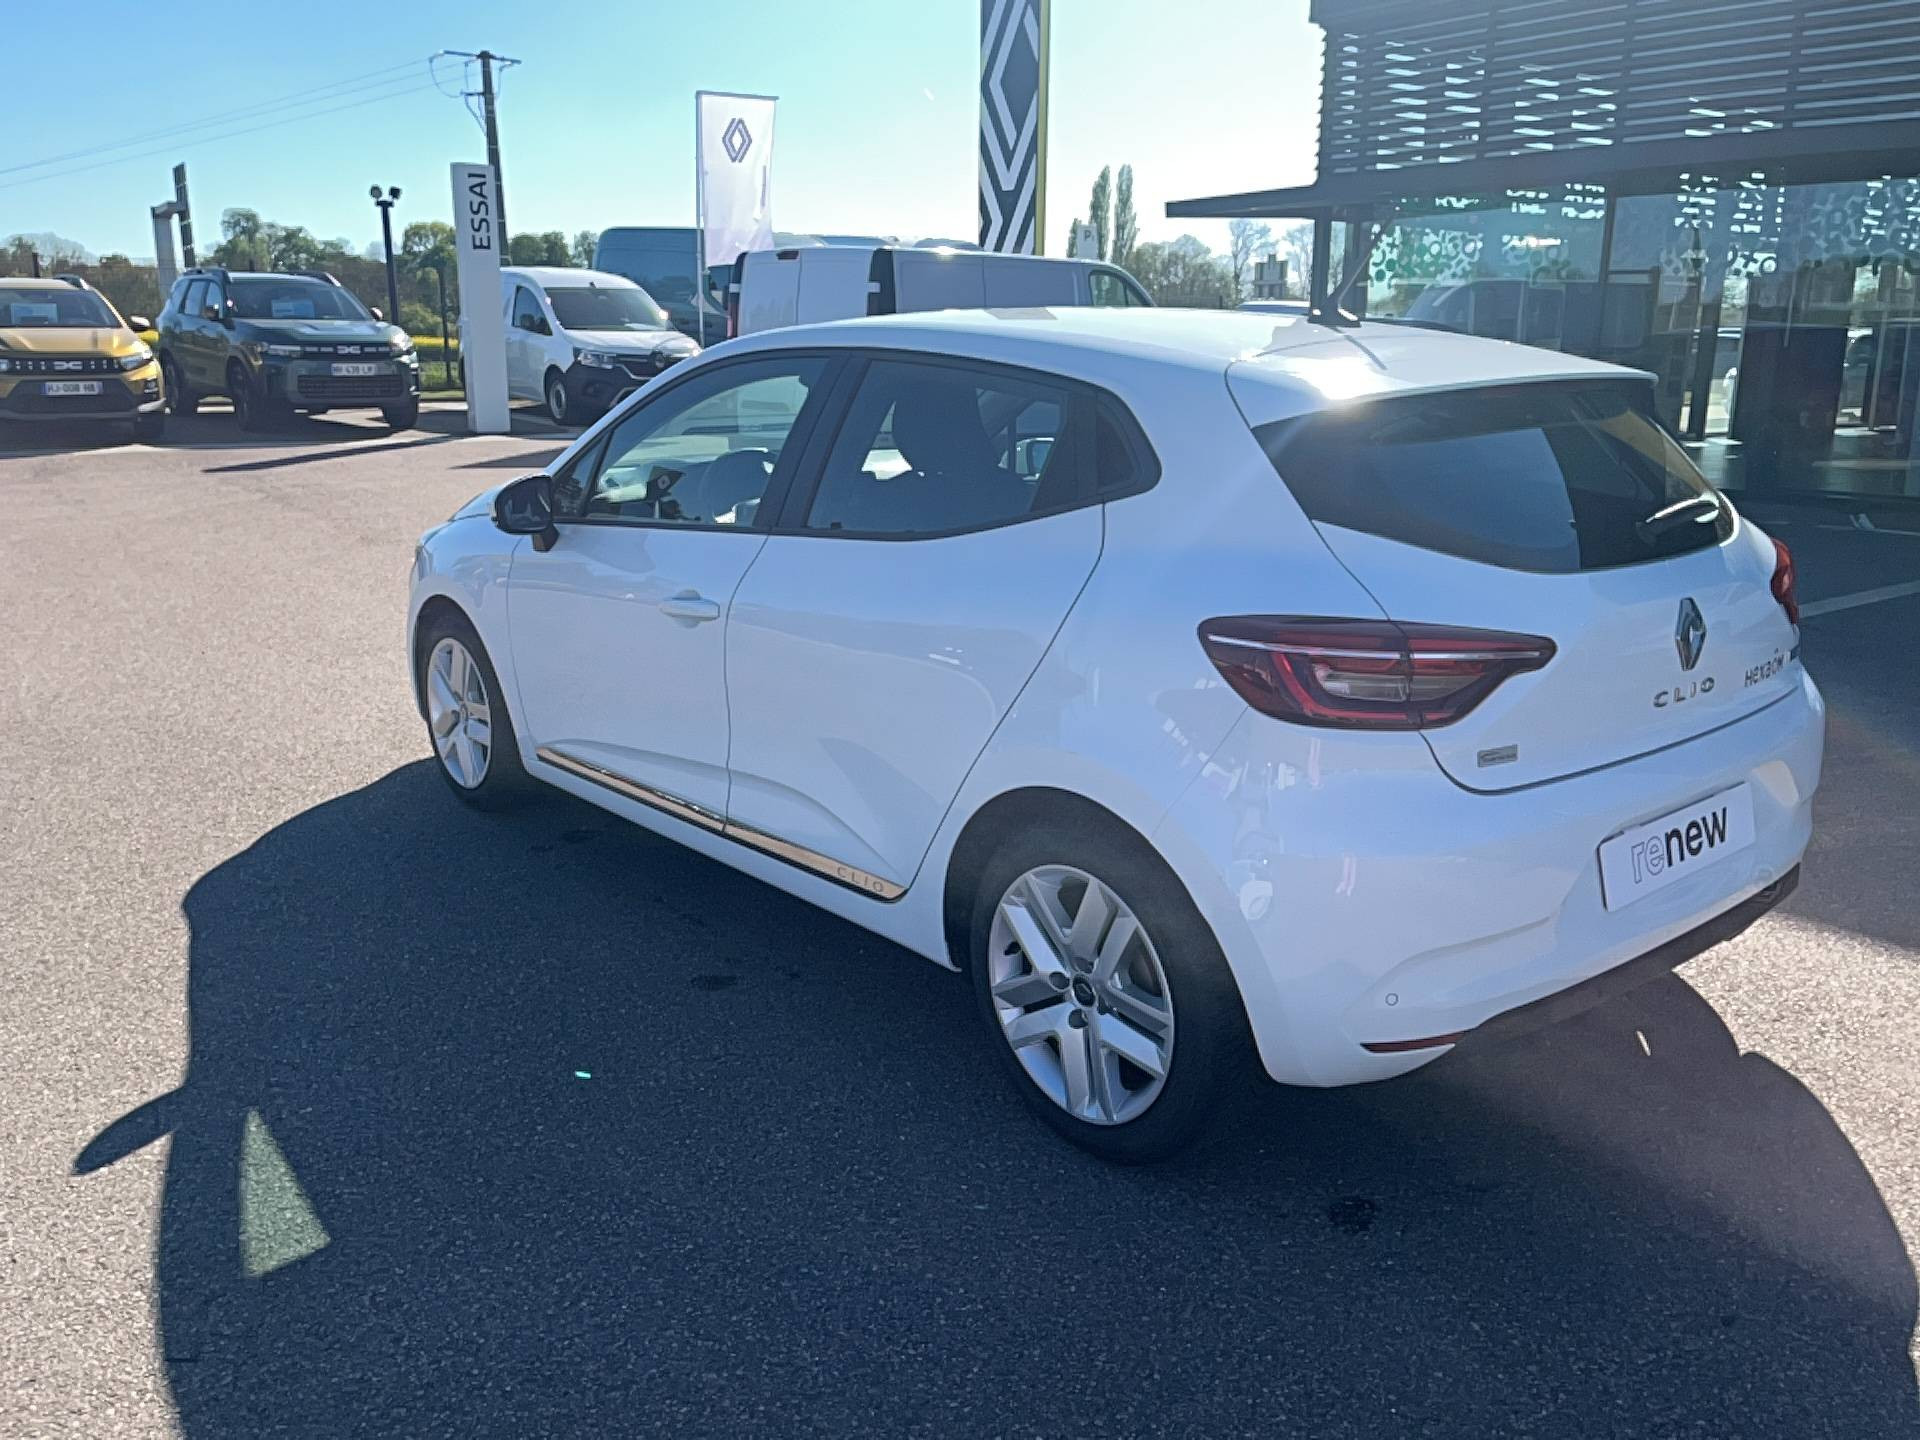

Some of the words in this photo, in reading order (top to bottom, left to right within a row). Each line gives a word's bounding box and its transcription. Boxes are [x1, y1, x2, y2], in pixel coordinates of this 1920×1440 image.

[467, 173, 491, 250] ESSAI
[1653, 677, 1715, 708] CLIO
[1631, 806, 1727, 884] renew
[837, 866, 884, 893] CLIO
